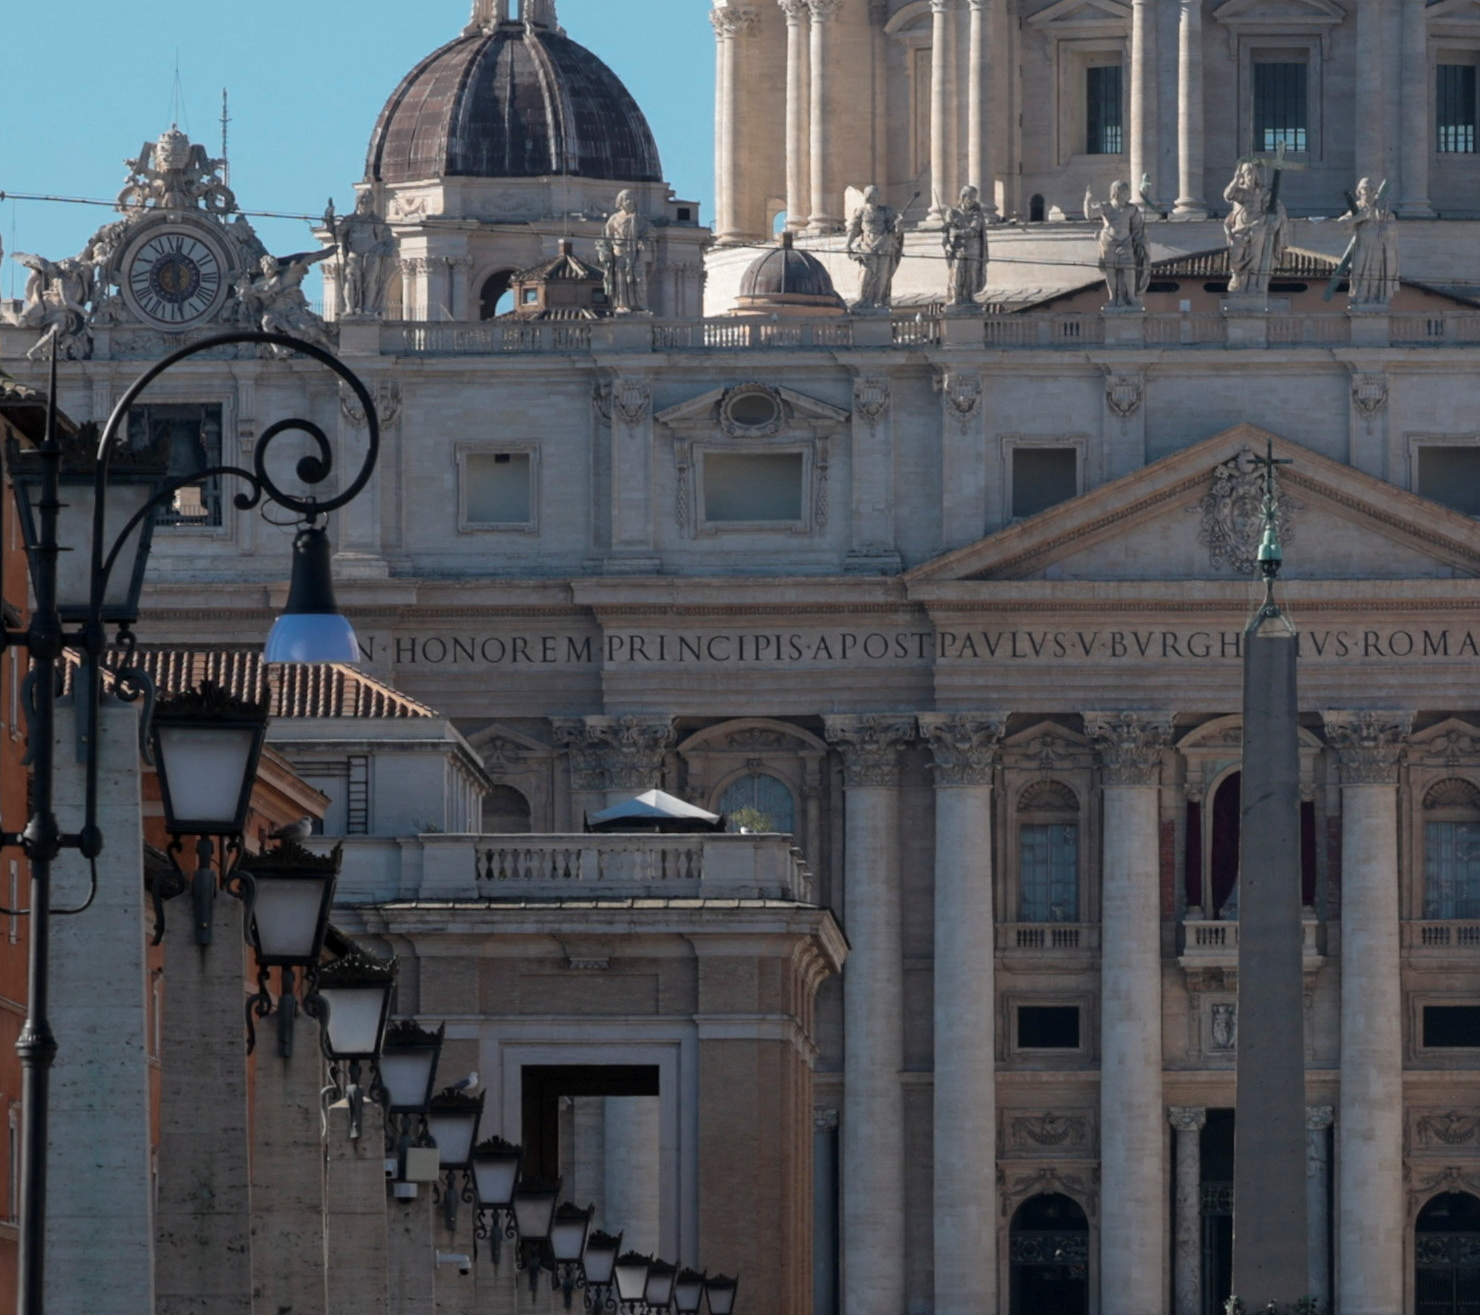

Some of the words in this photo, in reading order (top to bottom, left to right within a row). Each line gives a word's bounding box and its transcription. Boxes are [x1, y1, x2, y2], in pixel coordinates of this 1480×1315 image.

[395, 636, 593, 663] HONOREM
[607, 633, 803, 662] PRINCIPIS
[813, 632, 932, 661] APOST
[938, 630, 1067, 659] PAVLVS
[1075, 630, 1100, 658] V
